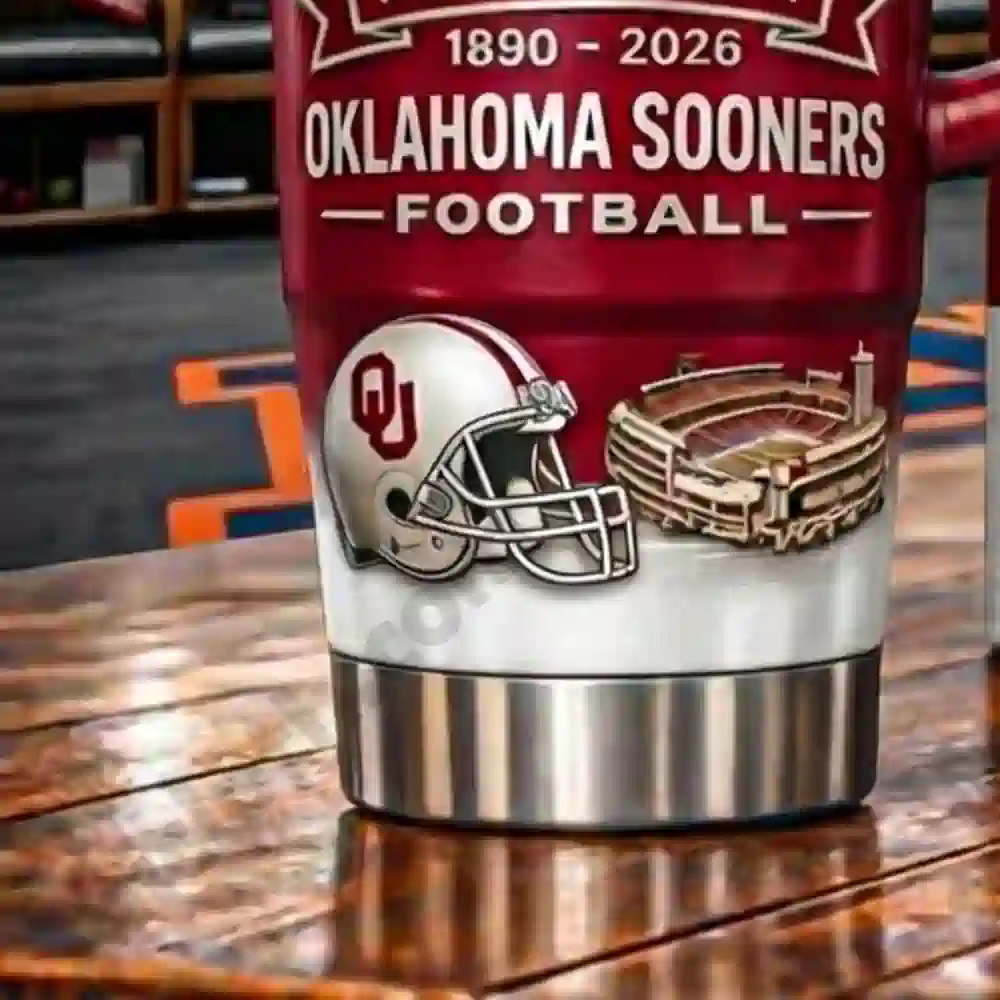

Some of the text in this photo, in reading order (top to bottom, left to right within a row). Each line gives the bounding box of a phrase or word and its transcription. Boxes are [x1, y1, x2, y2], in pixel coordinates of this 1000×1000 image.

[445, 27, 558, 67] 1890
[619, 27, 741, 66] 2026
[305, 91, 885, 179] OKLAHOMA SOONERS
[397, 192, 787, 235] FOOTBALL
[351, 351, 417, 461] OU
